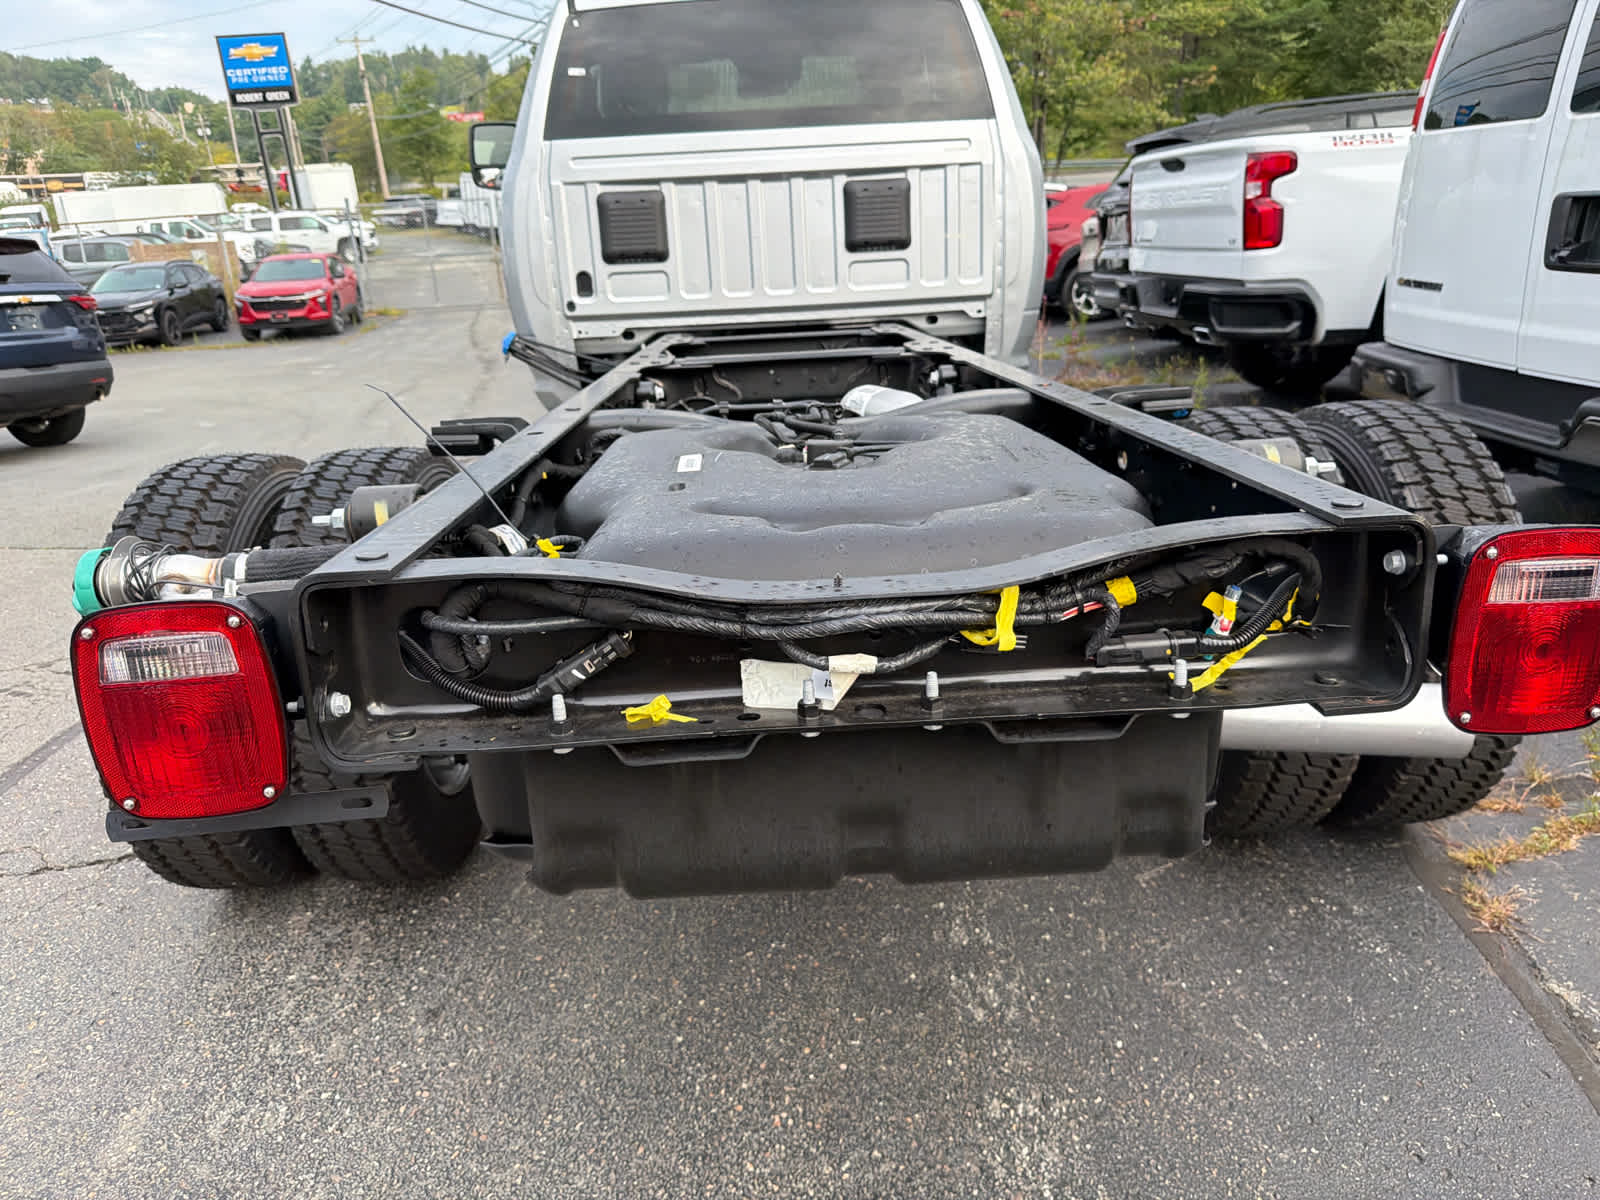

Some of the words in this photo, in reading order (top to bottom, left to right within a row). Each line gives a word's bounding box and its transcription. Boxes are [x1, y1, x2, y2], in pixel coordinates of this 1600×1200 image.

[226, 66, 288, 77] CERTIFIED
[235, 92, 264, 103] ROBERT
[265, 91, 291, 101] GREEN
